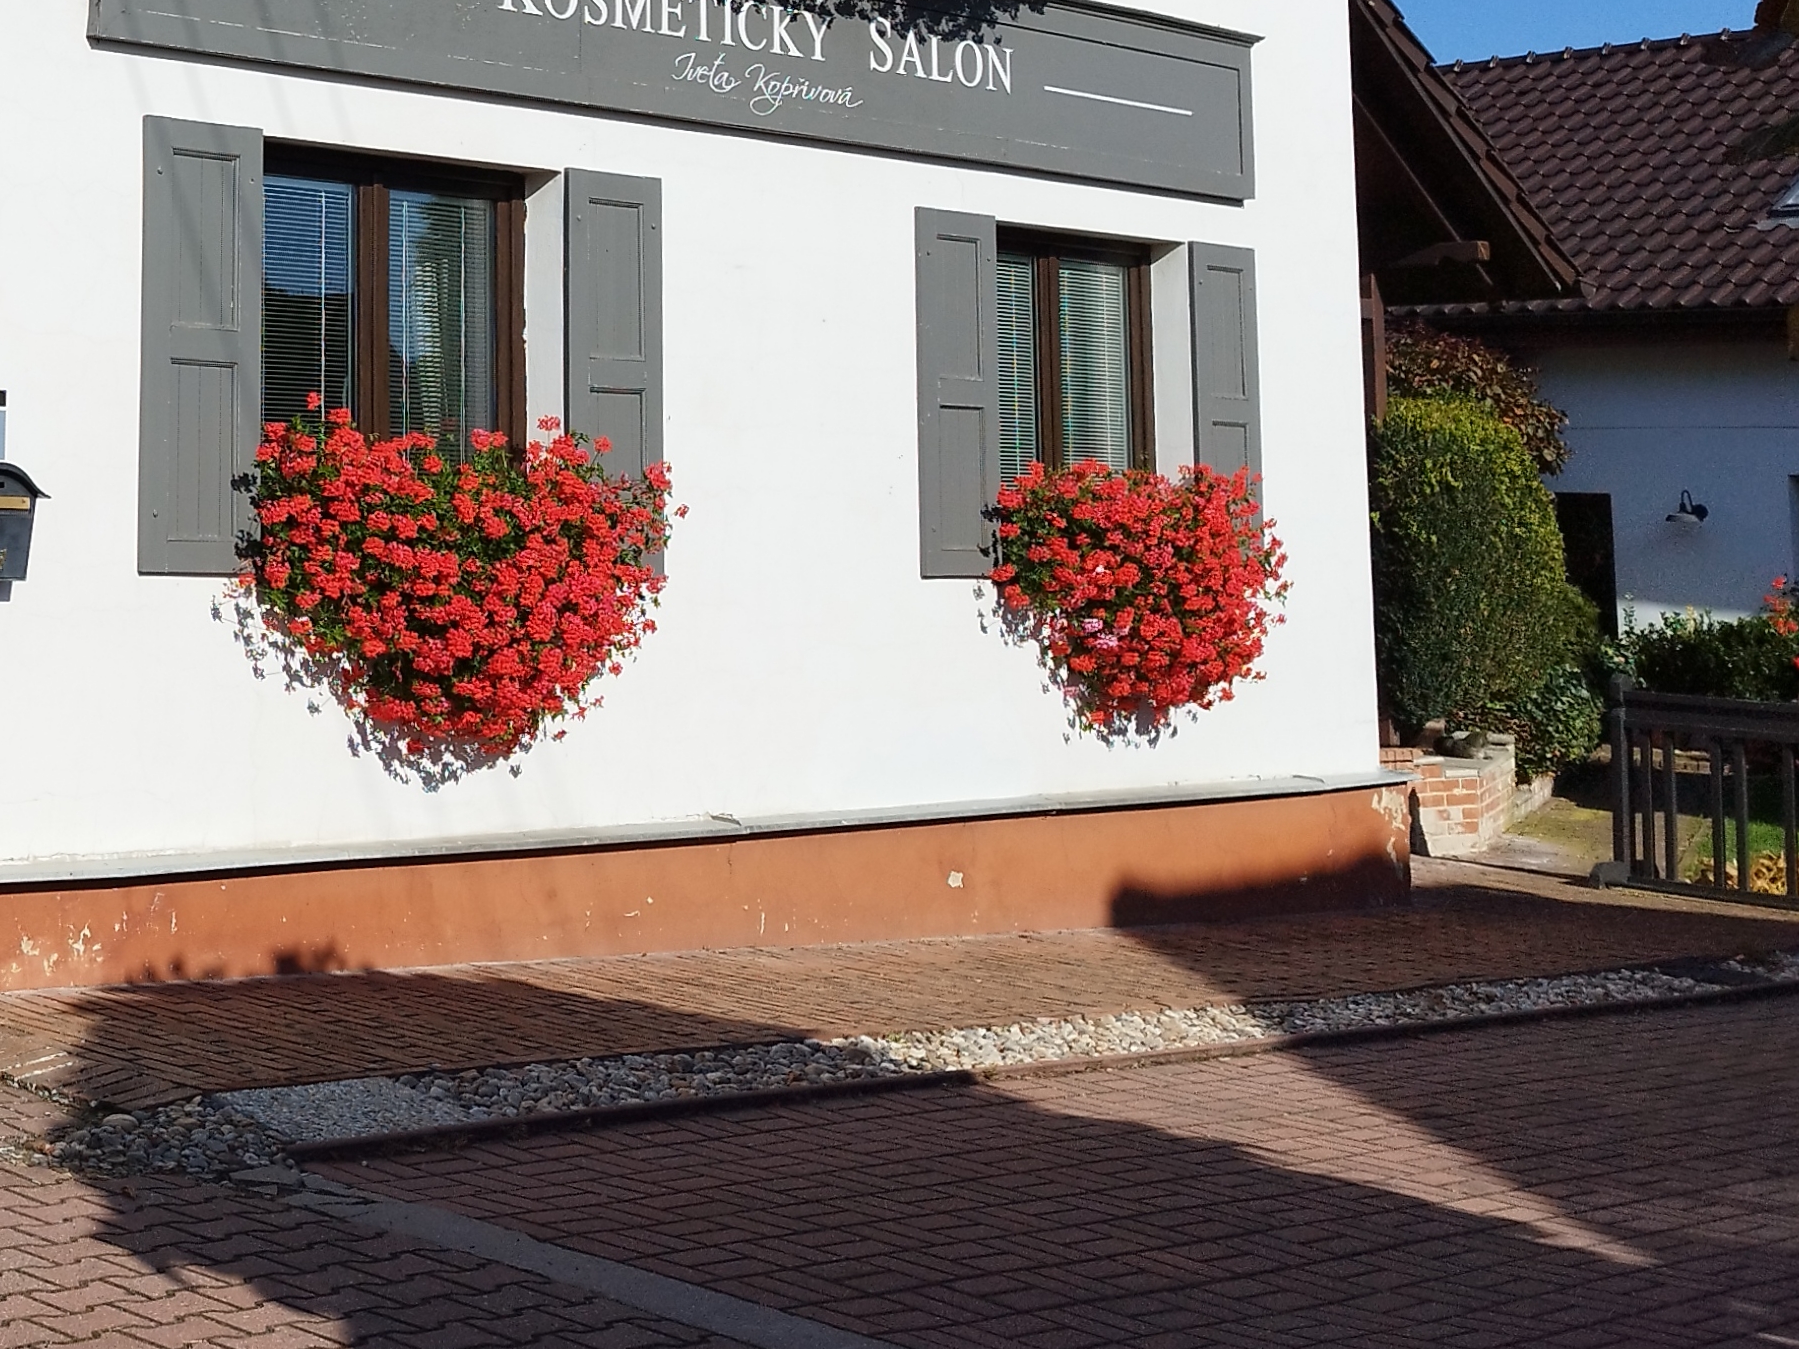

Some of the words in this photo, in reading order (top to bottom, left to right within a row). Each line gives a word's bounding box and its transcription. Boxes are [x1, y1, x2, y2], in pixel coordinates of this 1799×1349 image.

[671, 52, 743, 93] Iveta
[745, 63, 864, 116] Kopřivová
[869, 16, 1015, 95] SALON
